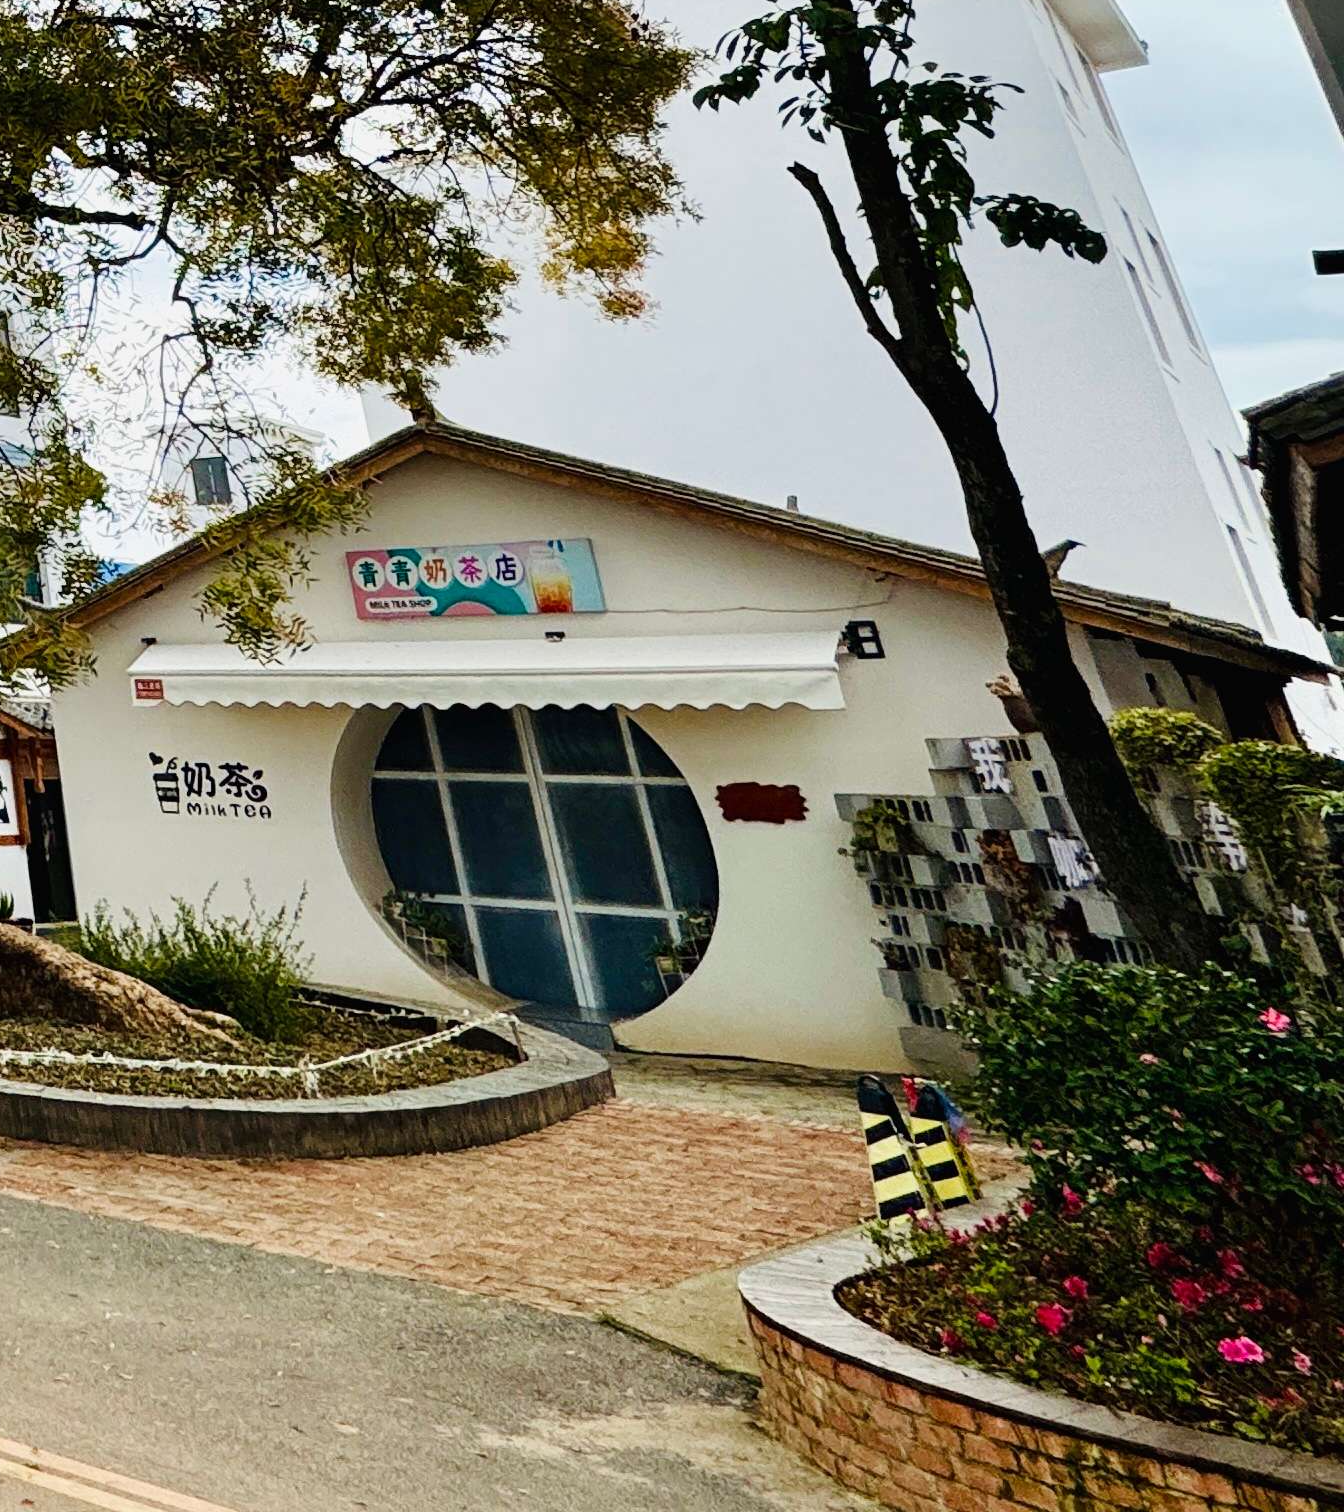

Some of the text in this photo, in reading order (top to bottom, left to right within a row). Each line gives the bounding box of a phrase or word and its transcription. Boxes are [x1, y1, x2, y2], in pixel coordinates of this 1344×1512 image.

[358, 554, 518, 587] 青青奶茶店
[181, 761, 253, 797] 奶茶
